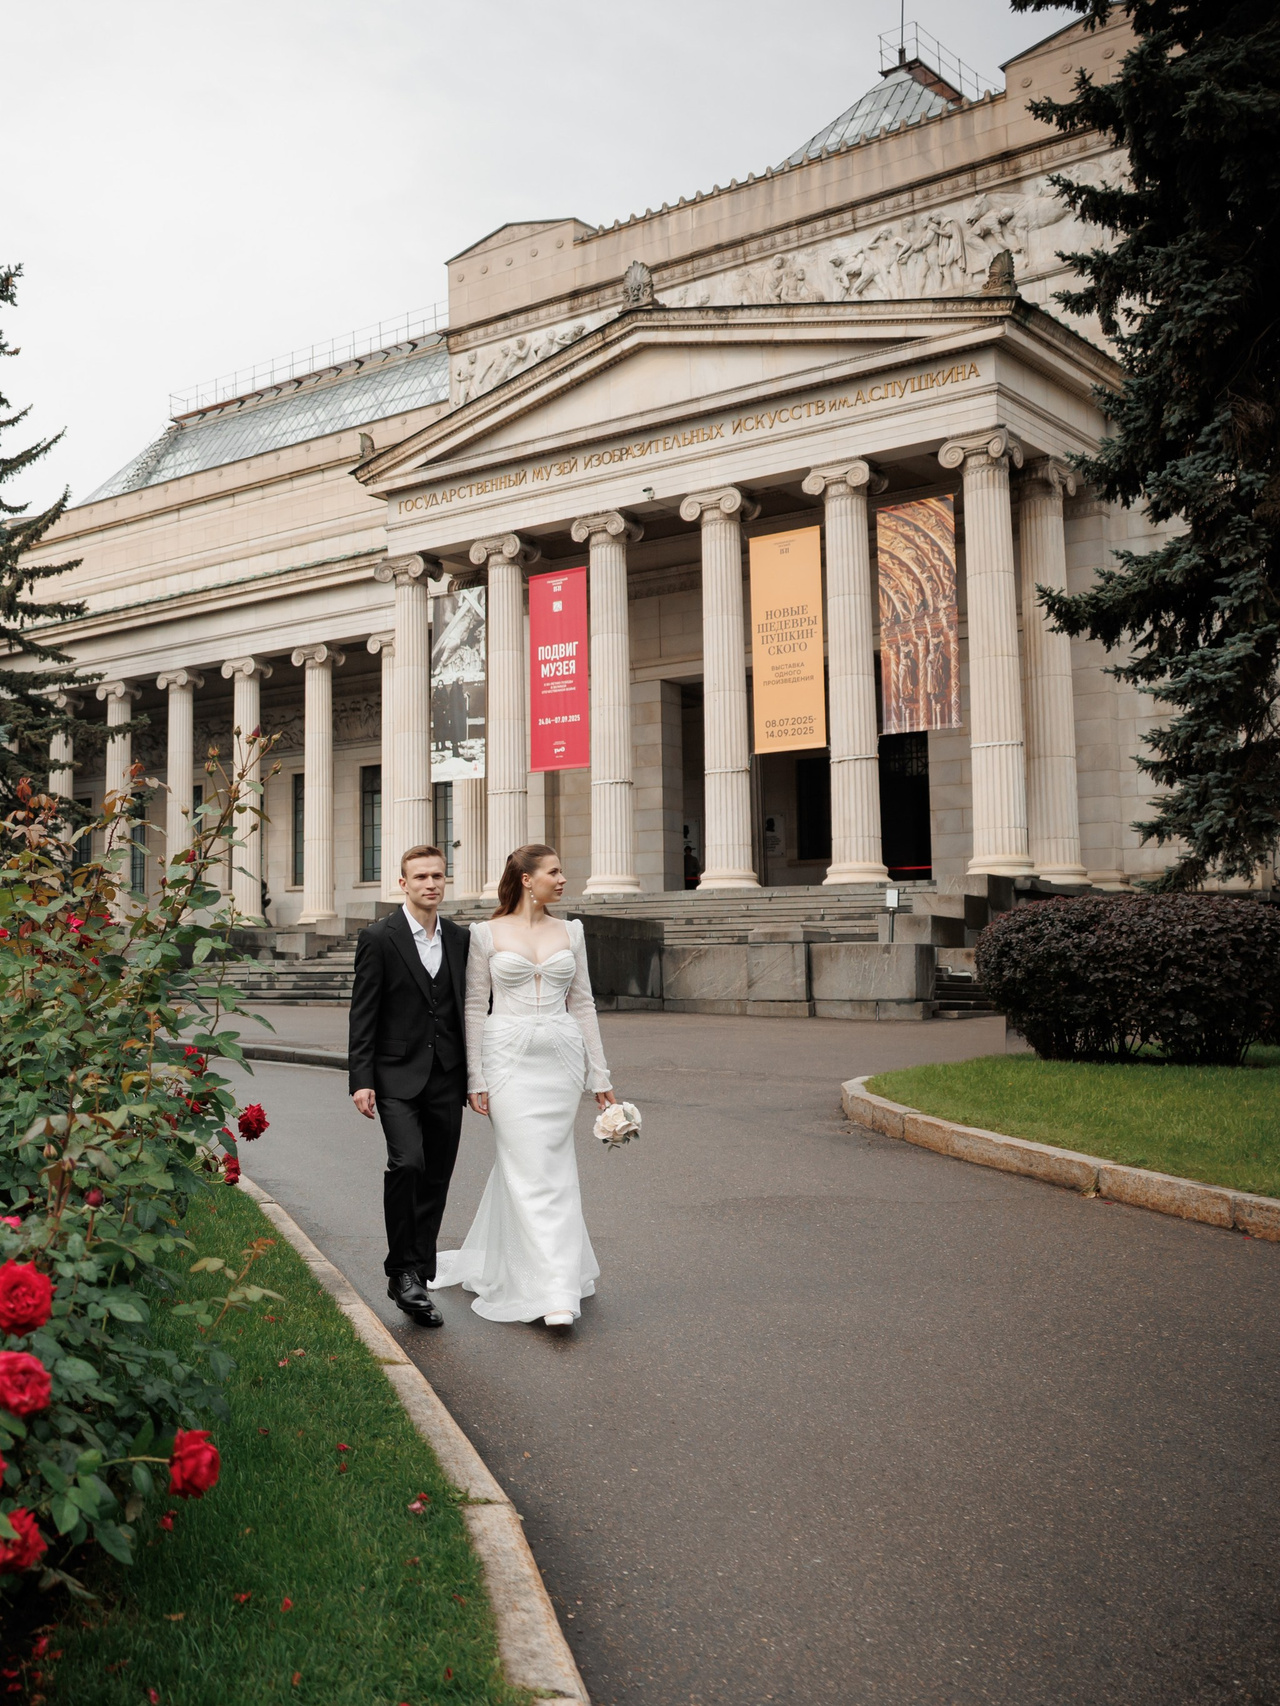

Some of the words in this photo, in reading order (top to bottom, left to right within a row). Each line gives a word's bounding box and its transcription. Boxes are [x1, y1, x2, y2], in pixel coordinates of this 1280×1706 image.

[398, 469, 527, 514] ГОСУДАРСТВЕННЫЙ
[531, 456, 578, 483] МУЗЕЙ
[583, 423, 725, 470] ИЗОБРАЗИТЕЛЬНЫХ
[732, 399, 826, 435] ИСКУССТВ
[765, 605, 808, 620] НОВЫЕ
[757, 616, 817, 634] ШЕДЕВРЫ
[761, 628, 817, 645] ПУШКИН-
[538, 641, 579, 661] ПОДВИГ
[768, 642, 808, 656] СКОГО
[541, 660, 576, 678] МУЗЕЯ
[771, 662, 805, 671] ВЫСТАВКА
[774, 669, 802, 678] ОДНОГО
[763, 675, 814, 687] ПРОИЗВЕДЕНИЯ
[765, 716, 817, 729] 08.07.2025-
[765, 726, 815, 739] 14.09.2025
